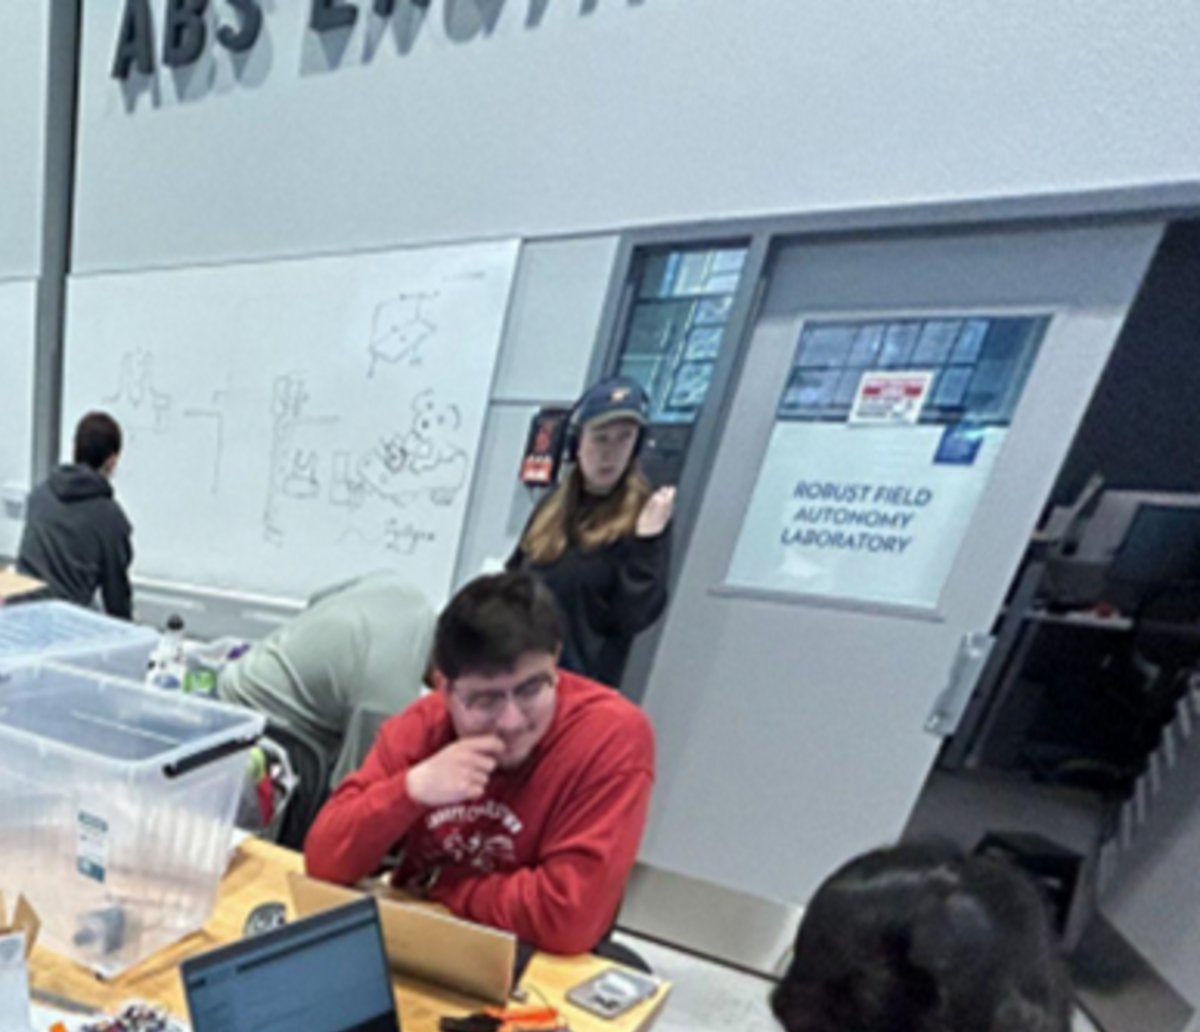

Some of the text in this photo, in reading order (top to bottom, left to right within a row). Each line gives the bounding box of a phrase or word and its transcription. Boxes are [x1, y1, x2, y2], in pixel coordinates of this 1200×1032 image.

[111, 0, 263, 80] ABS
[794, 482, 932, 506] ROBUST FIELD
[794, 507, 914, 528] AUTONOMY
[781, 529, 912, 553] LABORATORY
